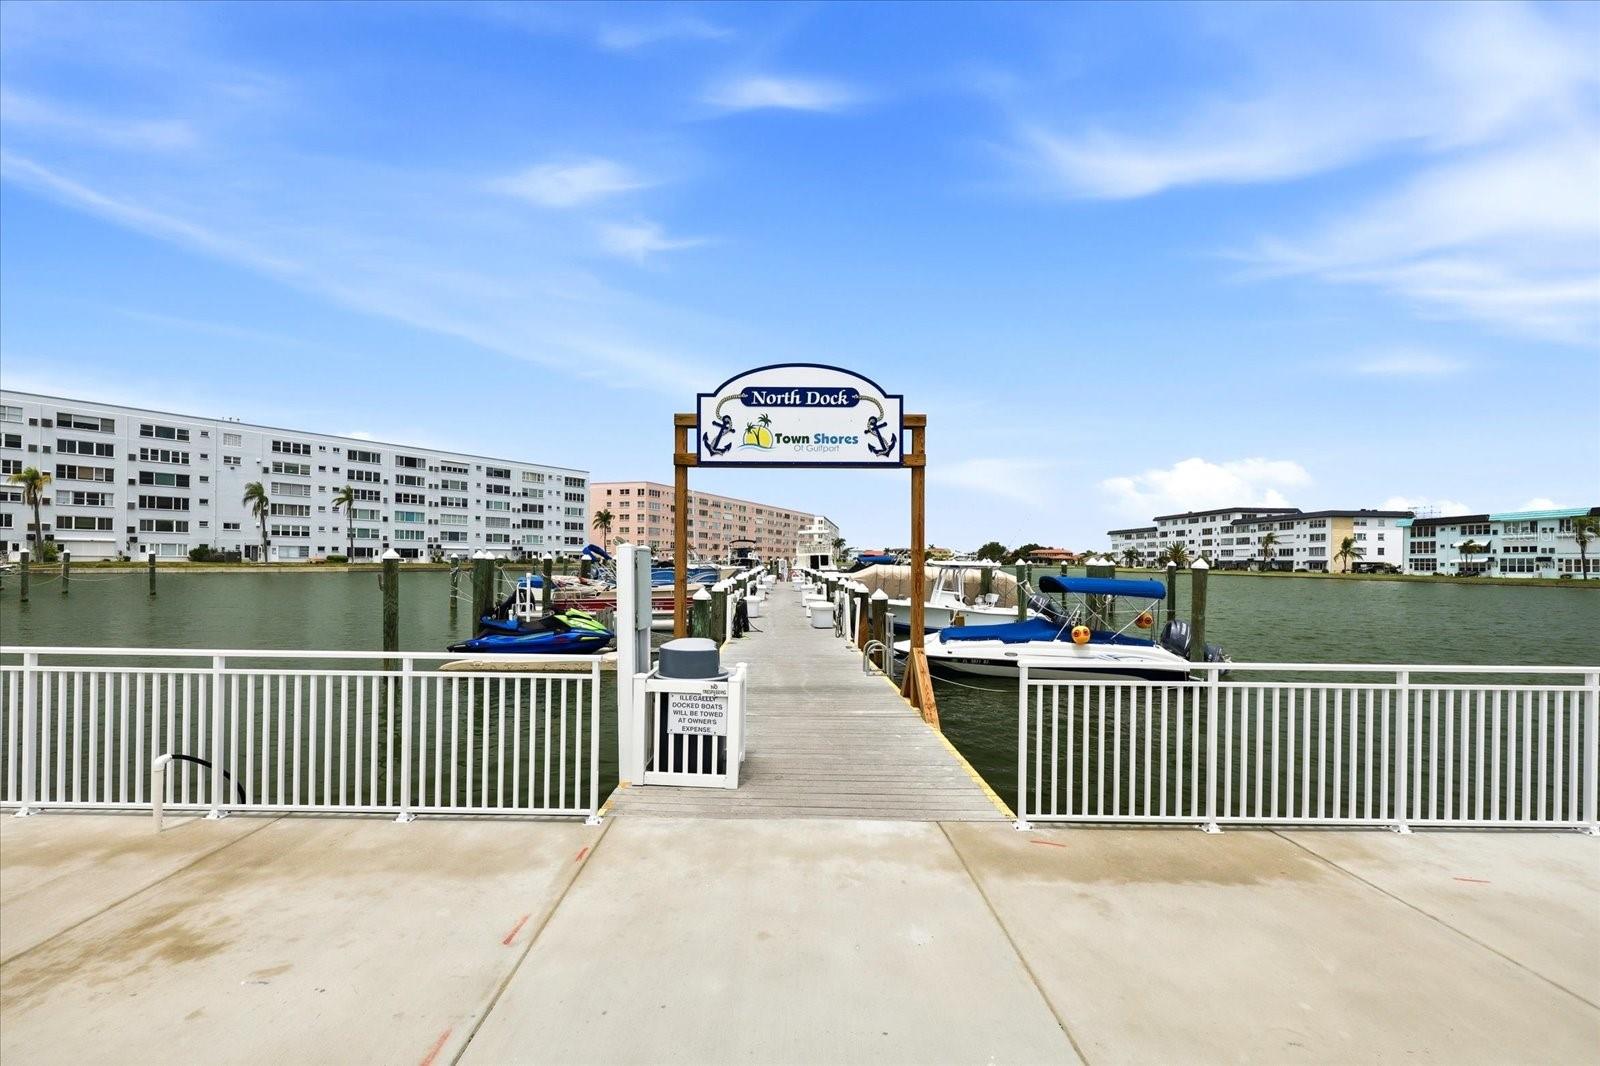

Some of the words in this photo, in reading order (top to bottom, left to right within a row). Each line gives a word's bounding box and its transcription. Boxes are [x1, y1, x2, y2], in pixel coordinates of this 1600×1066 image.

[751, 390, 802, 405] North
[806, 390, 848, 405] Dock
[775, 433, 810, 444] Town
[813, 433, 859, 445] Shores
[793, 445, 804, 453] Of
[806, 445, 840, 454] Gulfport
